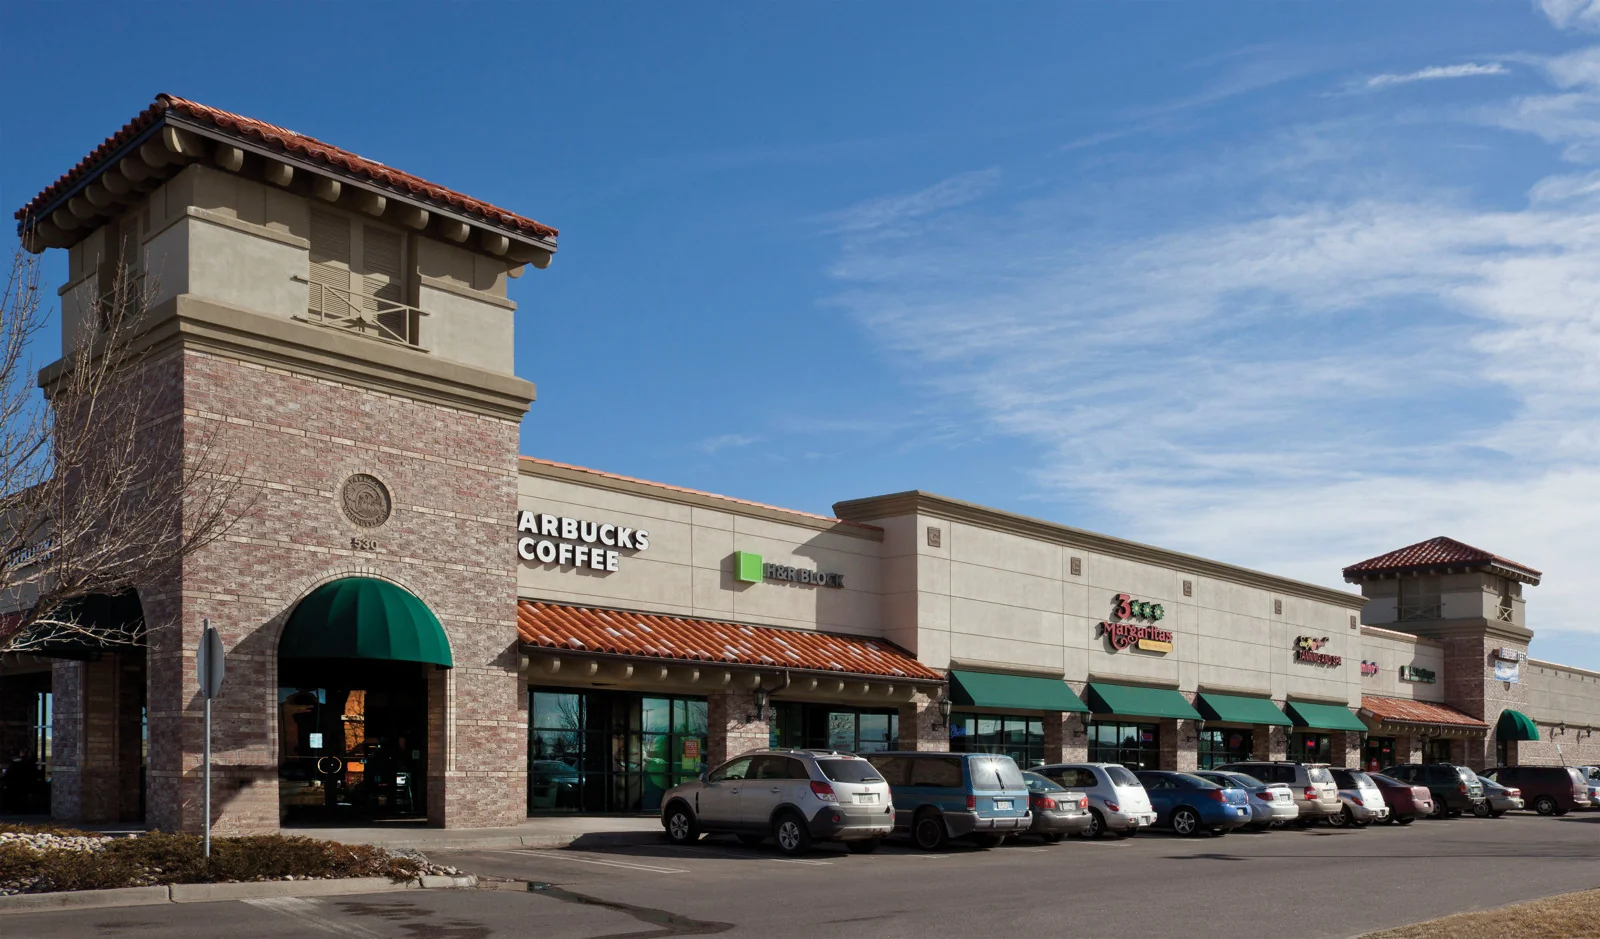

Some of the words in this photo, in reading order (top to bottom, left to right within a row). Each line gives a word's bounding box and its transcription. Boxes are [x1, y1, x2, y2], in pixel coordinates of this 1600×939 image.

[517, 510, 650, 551] ARBUCKS
[518, 537, 619, 572] COFFEE
[765, 563, 797, 581] H&R
[799, 568, 845, 588] BLOCK
[1117, 594, 1132, 619] 3
[1103, 621, 1173, 650] Margaritas
